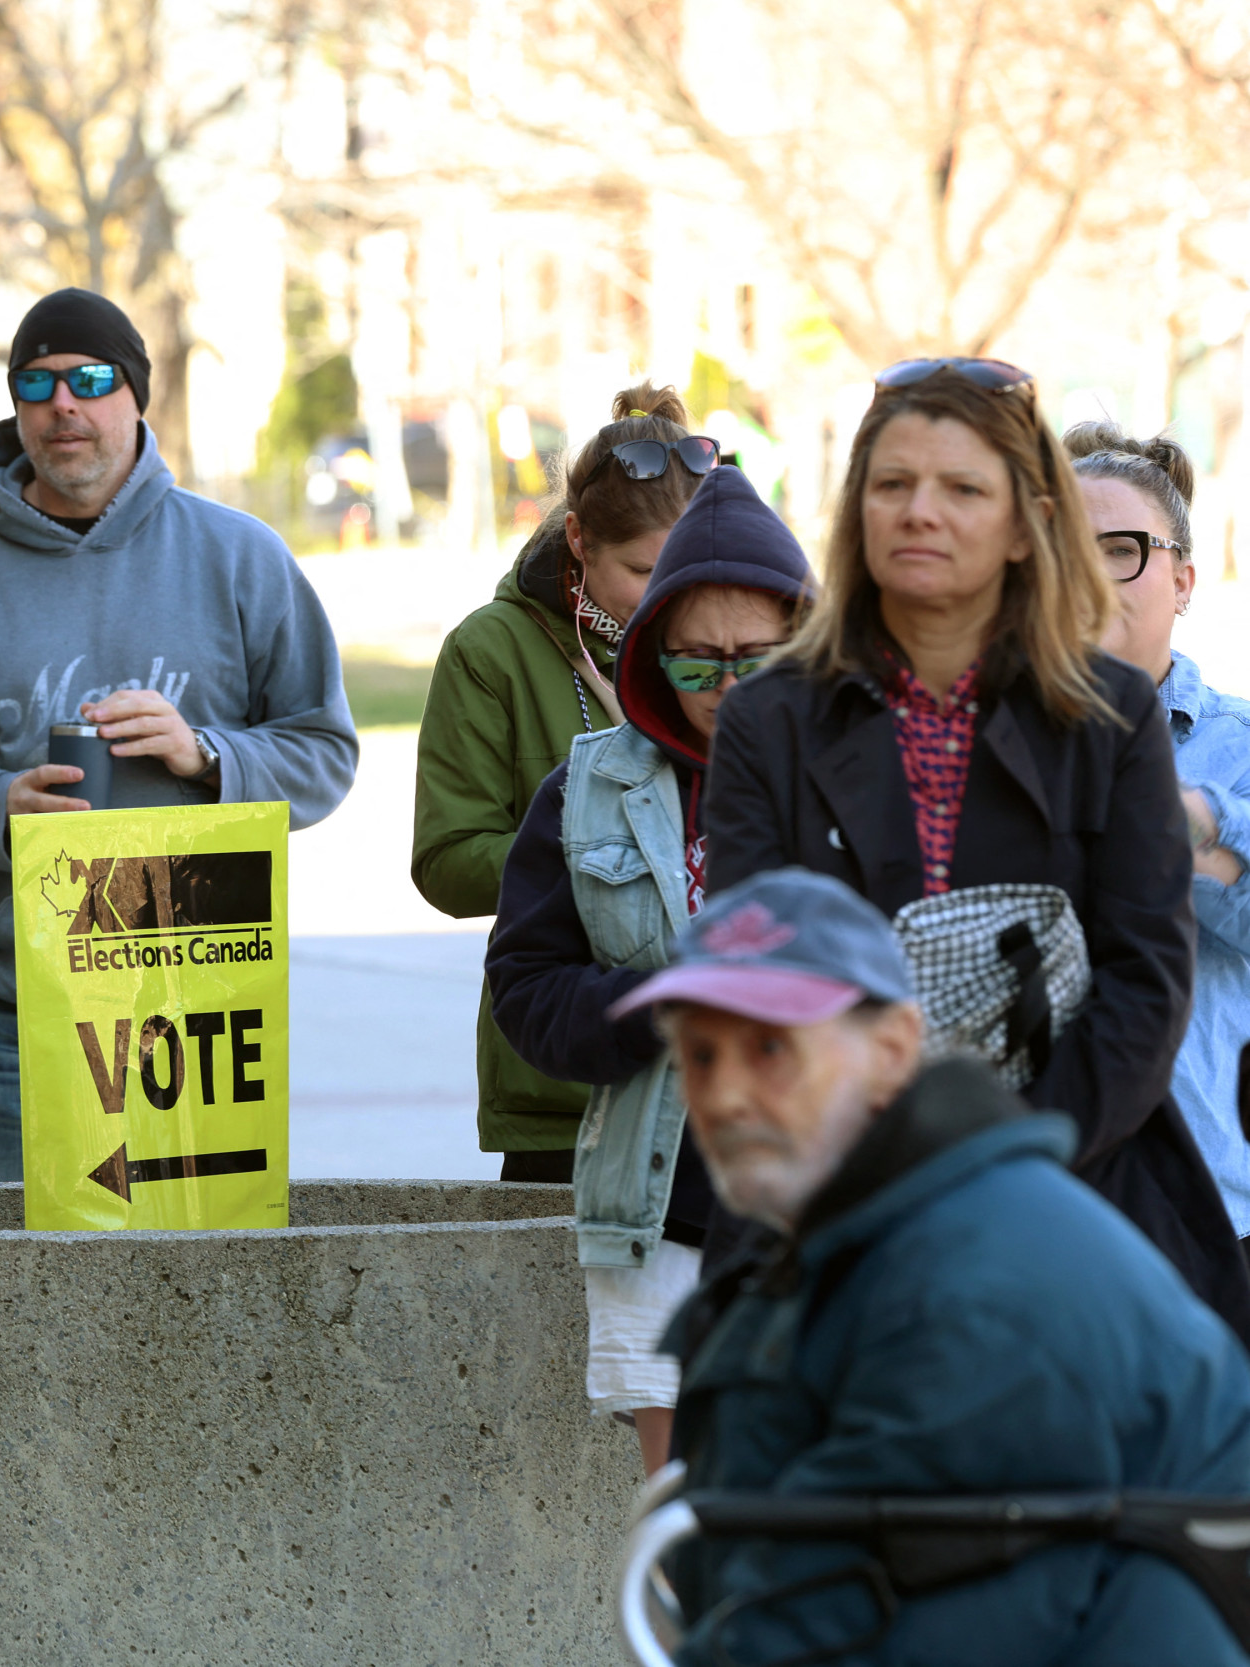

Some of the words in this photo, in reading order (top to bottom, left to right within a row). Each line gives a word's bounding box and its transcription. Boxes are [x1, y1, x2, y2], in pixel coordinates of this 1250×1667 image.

[66, 937, 183, 974] Elections
[188, 927, 273, 965] Canada
[75, 1008, 265, 1115] VOTE
